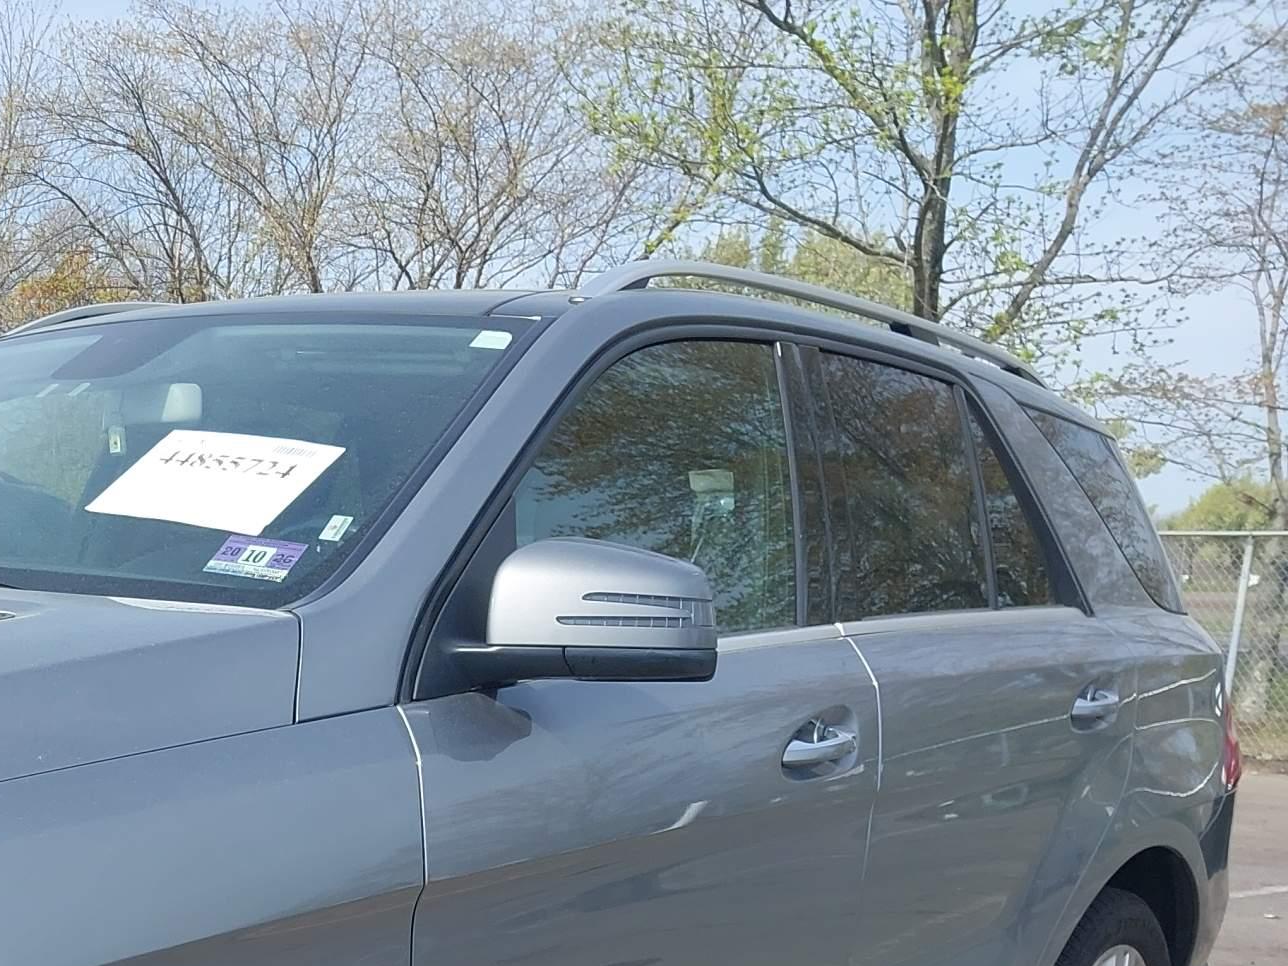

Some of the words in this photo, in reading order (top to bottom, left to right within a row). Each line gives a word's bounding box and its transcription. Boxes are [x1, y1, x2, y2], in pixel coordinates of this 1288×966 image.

[160, 450, 298, 478] 44855724
[221, 546, 241, 557] 20
[242, 549, 267, 563] 10
[272, 553, 296, 564] 26
